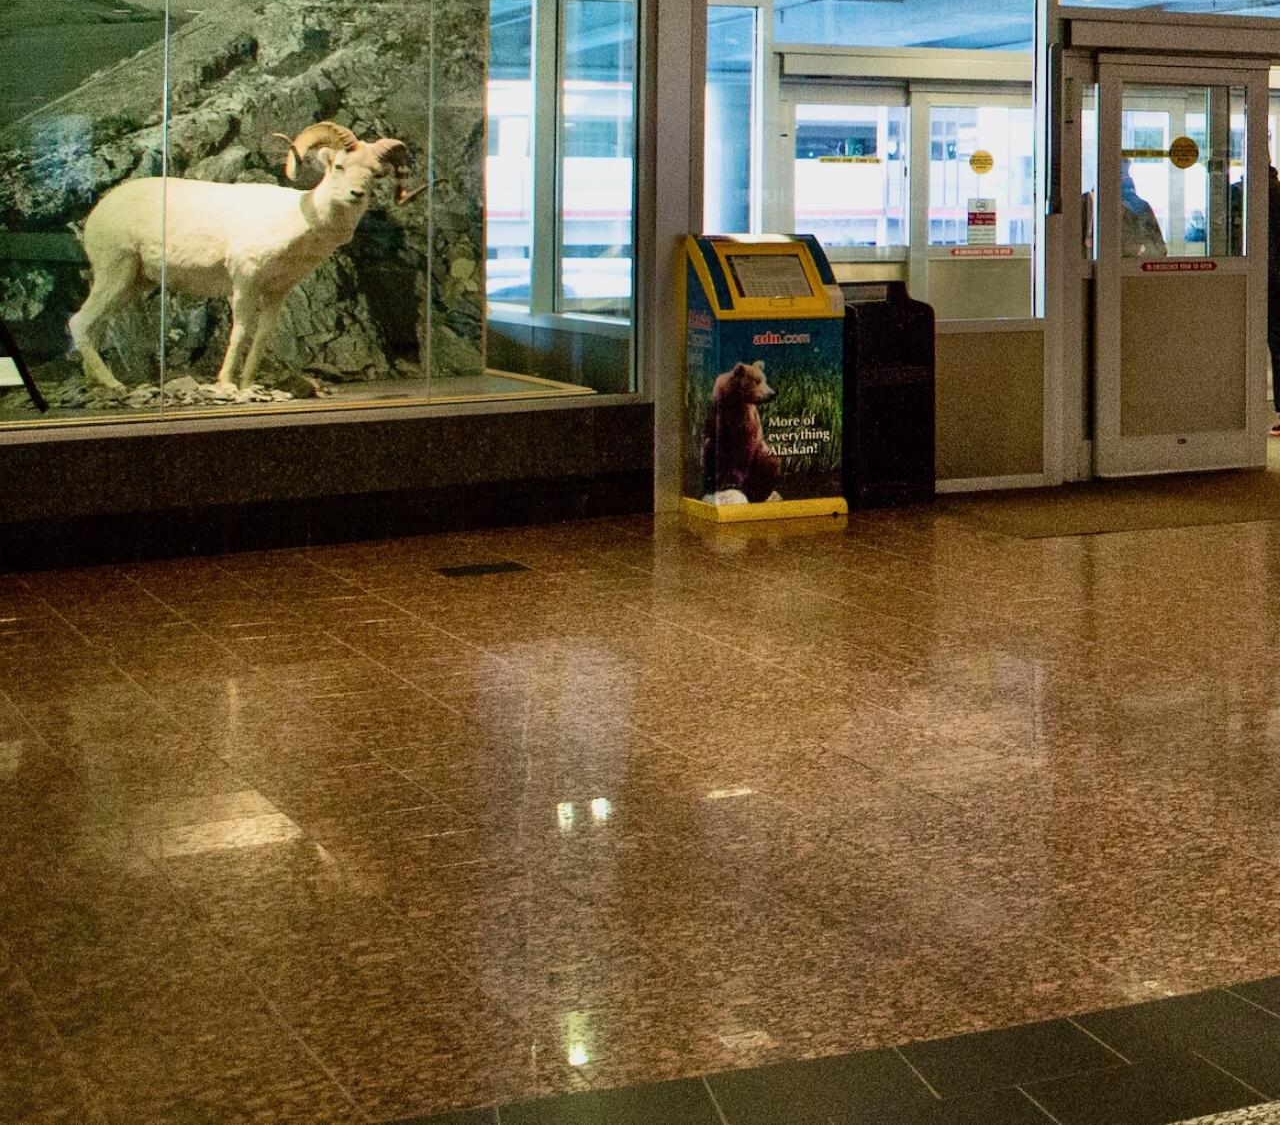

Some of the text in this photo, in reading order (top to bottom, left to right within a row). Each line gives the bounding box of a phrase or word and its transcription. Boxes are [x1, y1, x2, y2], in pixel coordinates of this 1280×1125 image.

[752, 329, 811, 346] adn.com
[768, 414, 816, 427] More of
[768, 427, 831, 444] everything
[767, 443, 818, 456] Alaskan!
